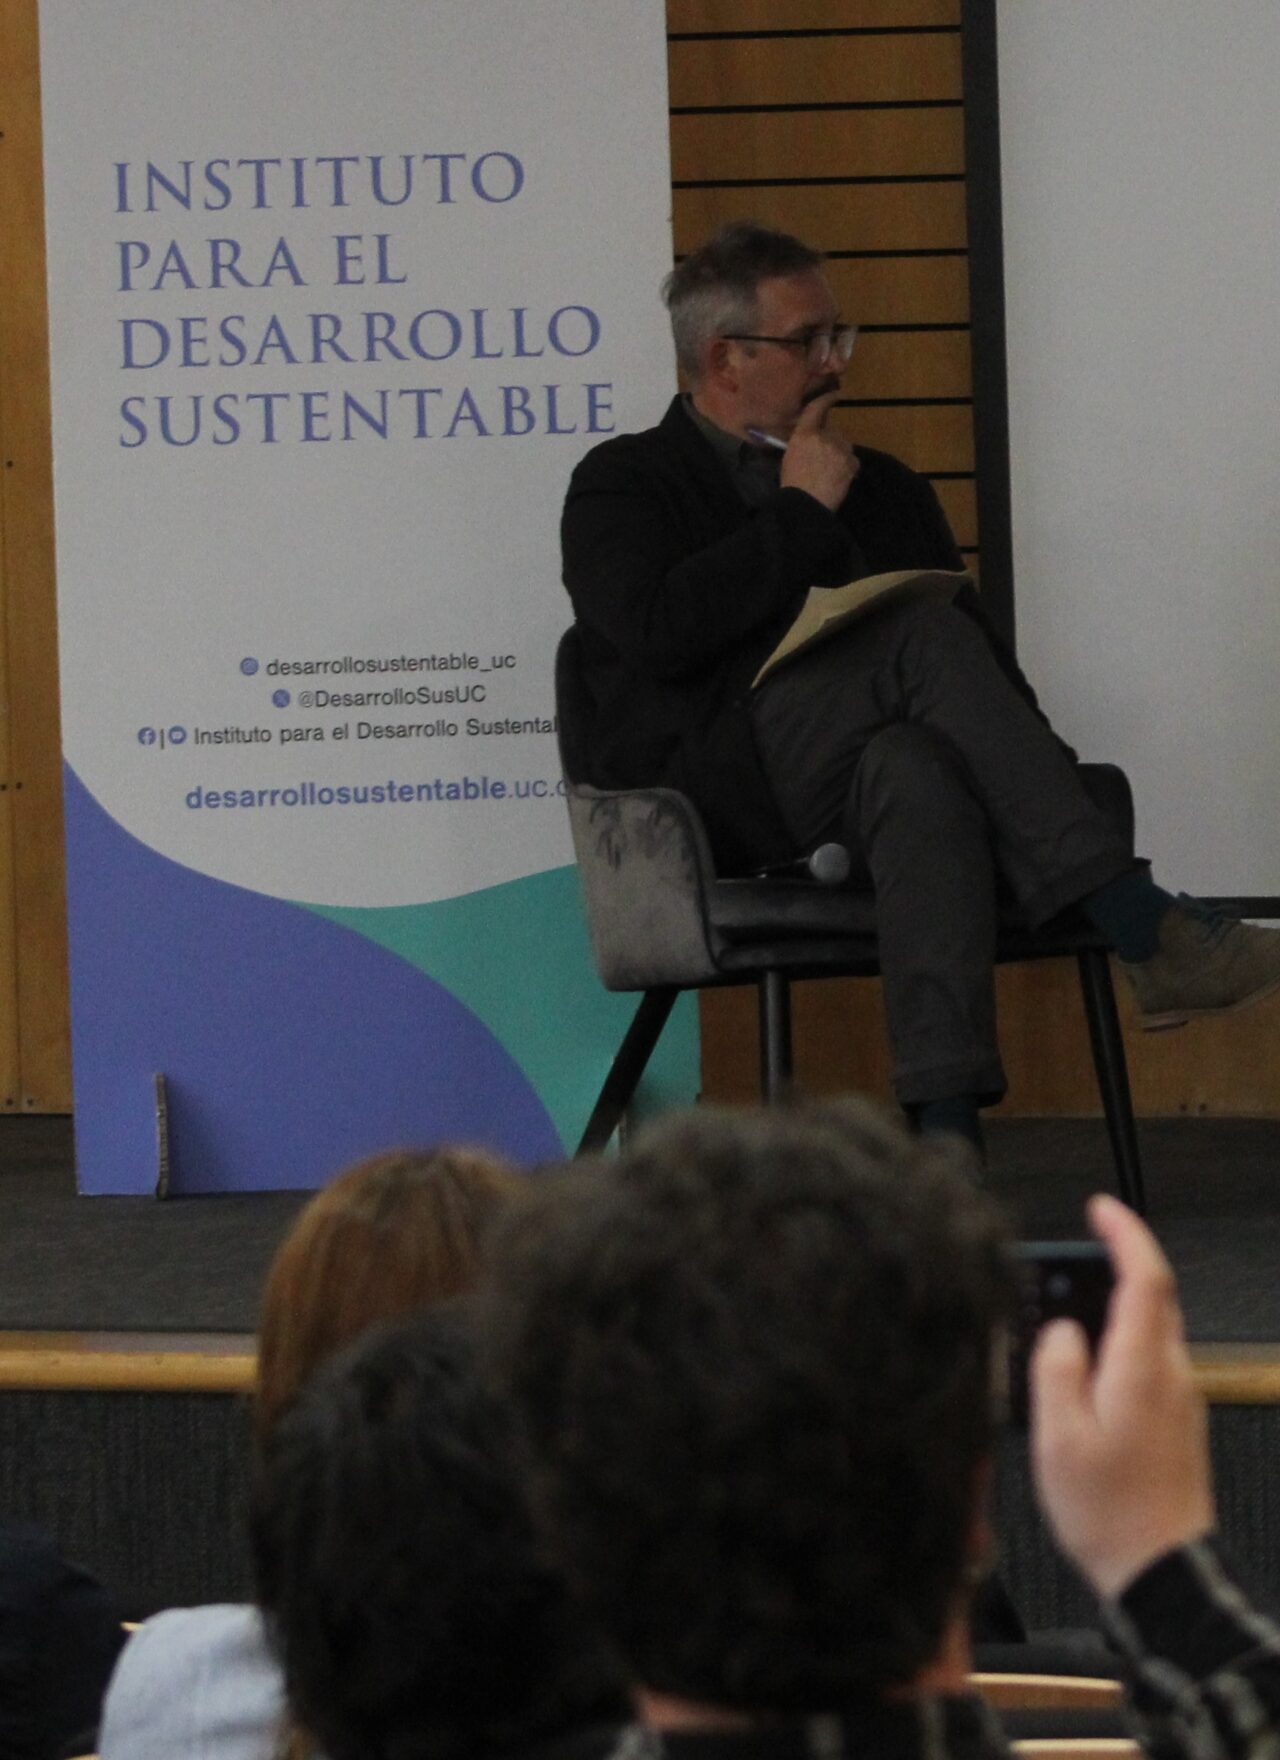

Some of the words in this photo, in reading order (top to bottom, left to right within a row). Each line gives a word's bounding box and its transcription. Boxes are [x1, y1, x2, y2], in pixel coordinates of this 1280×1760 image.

[113, 151, 525, 213] INSTITUTO
[115, 236, 310, 292] PARA
[331, 233, 408, 286] EL
[117, 305, 602, 370] DESARROLLO
[118, 382, 616, 448] SUSTENTABLE
[265, 652, 517, 677] desarrollosustentable_uc
[299, 684, 487, 708] @DesarrolloSusUC
[194, 726, 272, 745] Instituto
[279, 727, 324, 747] para
[332, 722, 349, 740] el
[357, 719, 458, 740] Desarrollo
[466, 716, 559, 736] Sustenta
